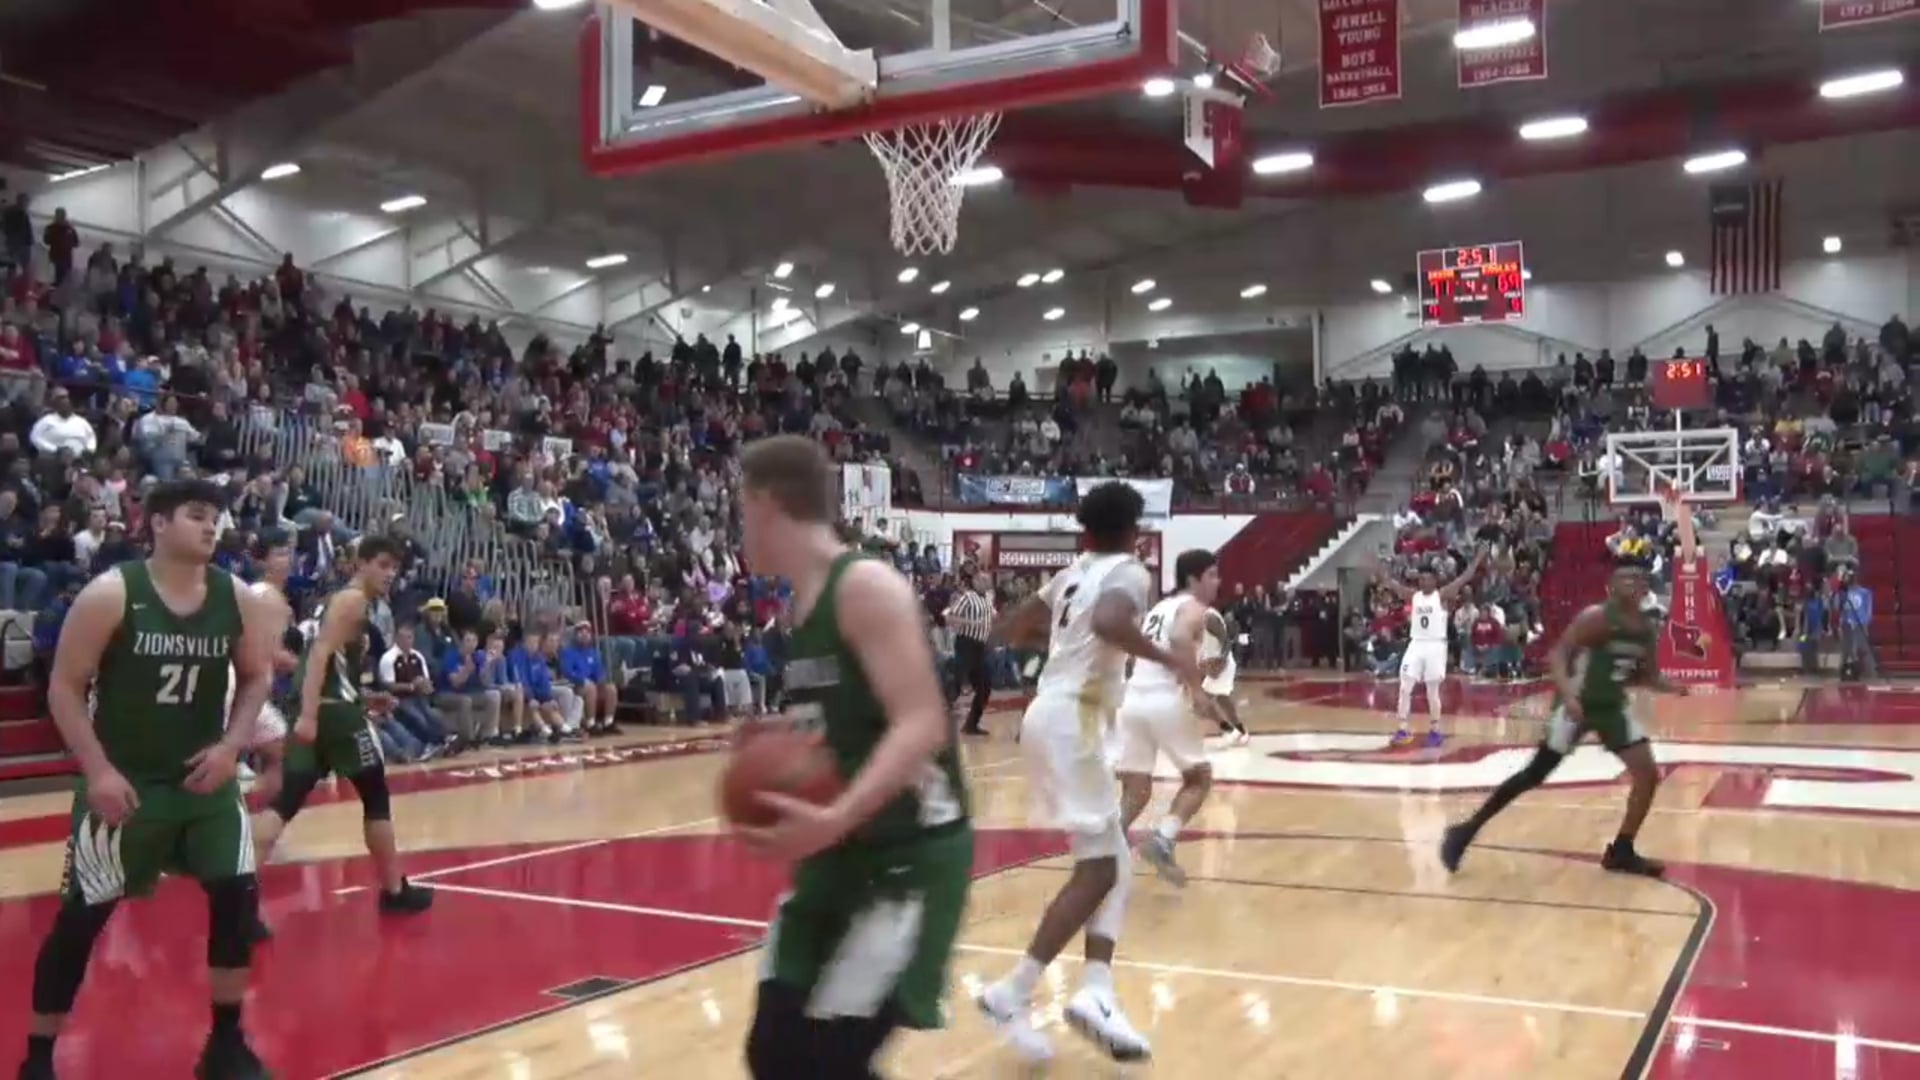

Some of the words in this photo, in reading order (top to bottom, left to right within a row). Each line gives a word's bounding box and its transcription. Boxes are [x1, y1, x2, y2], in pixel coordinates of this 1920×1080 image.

[1337, 26, 1381, 46] YOUNG
[1341, 49, 1376, 68] BOYS
[1666, 361, 1701, 379] 2:51
[1420, 615, 1430, 630] 0
[156, 663, 201, 704] 21
